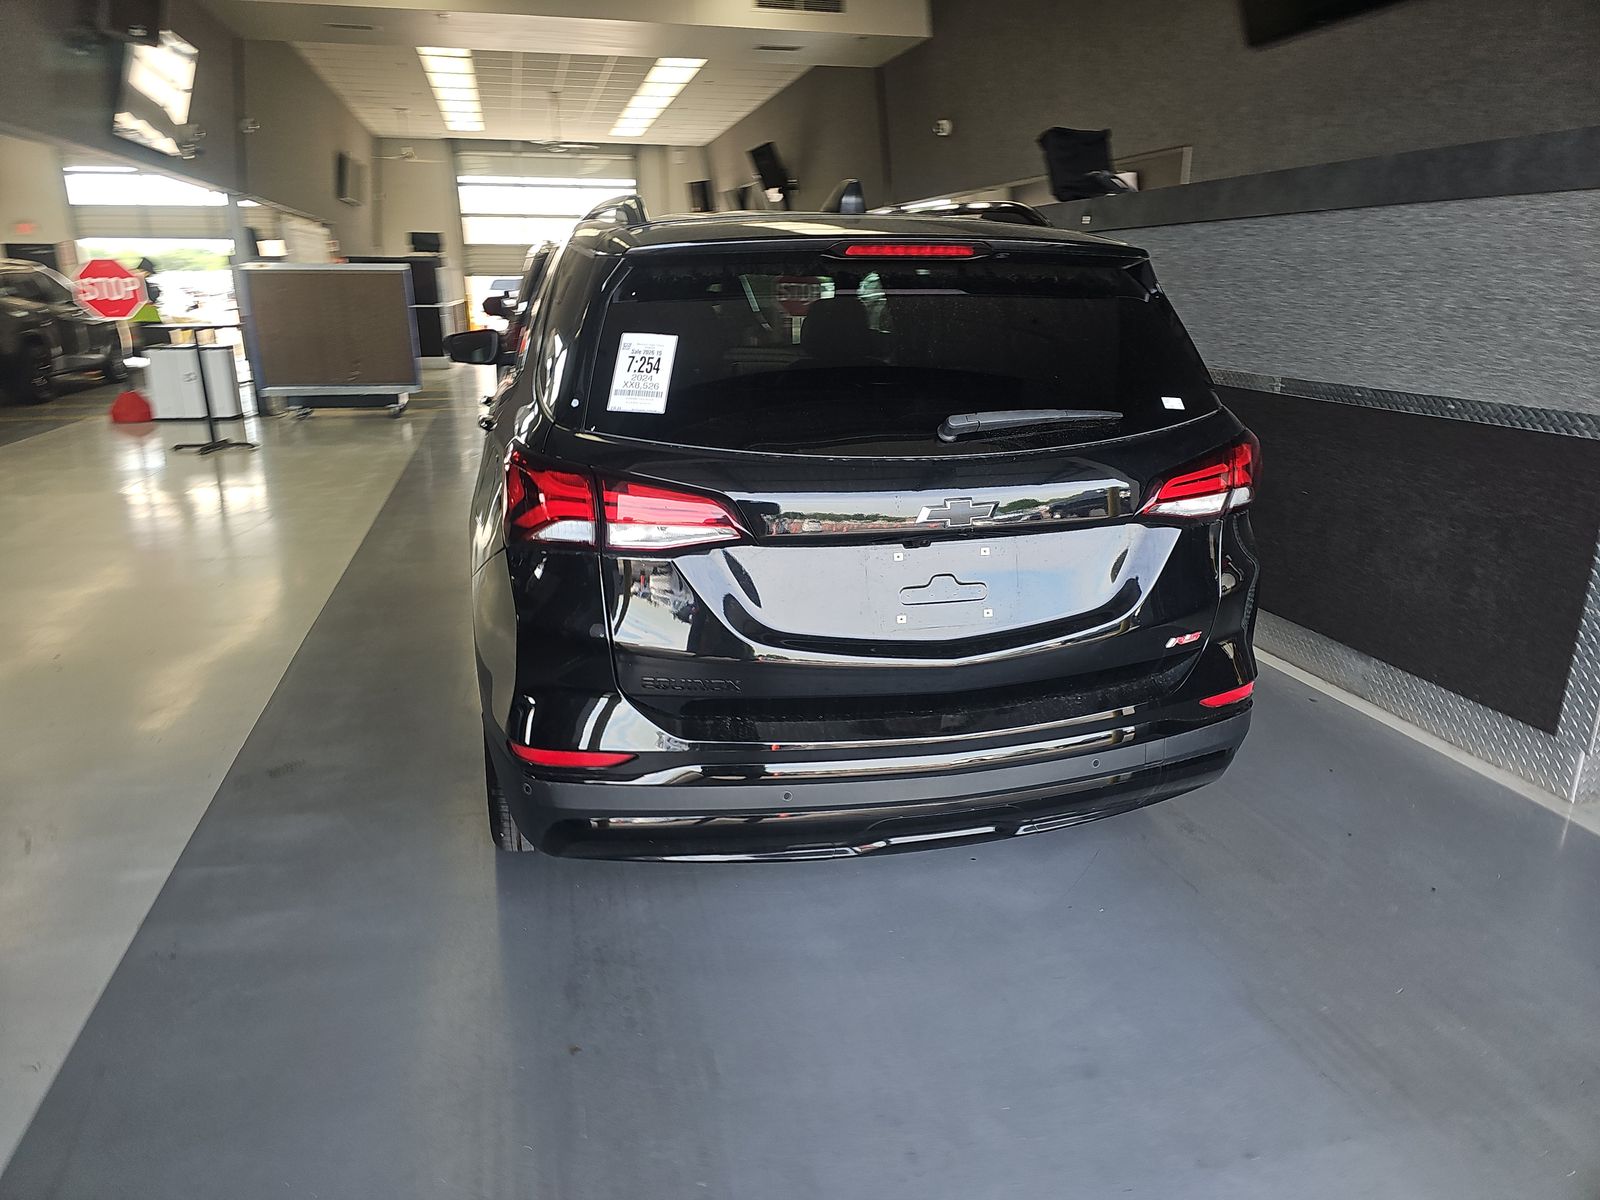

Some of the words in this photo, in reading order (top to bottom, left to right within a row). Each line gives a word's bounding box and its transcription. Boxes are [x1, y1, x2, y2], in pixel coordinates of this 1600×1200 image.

[78, 277, 140, 300] STOP
[627, 355, 661, 374] 7:254
[631, 374, 653, 382] 2024
[641, 676, 742, 692] EQUINOX
